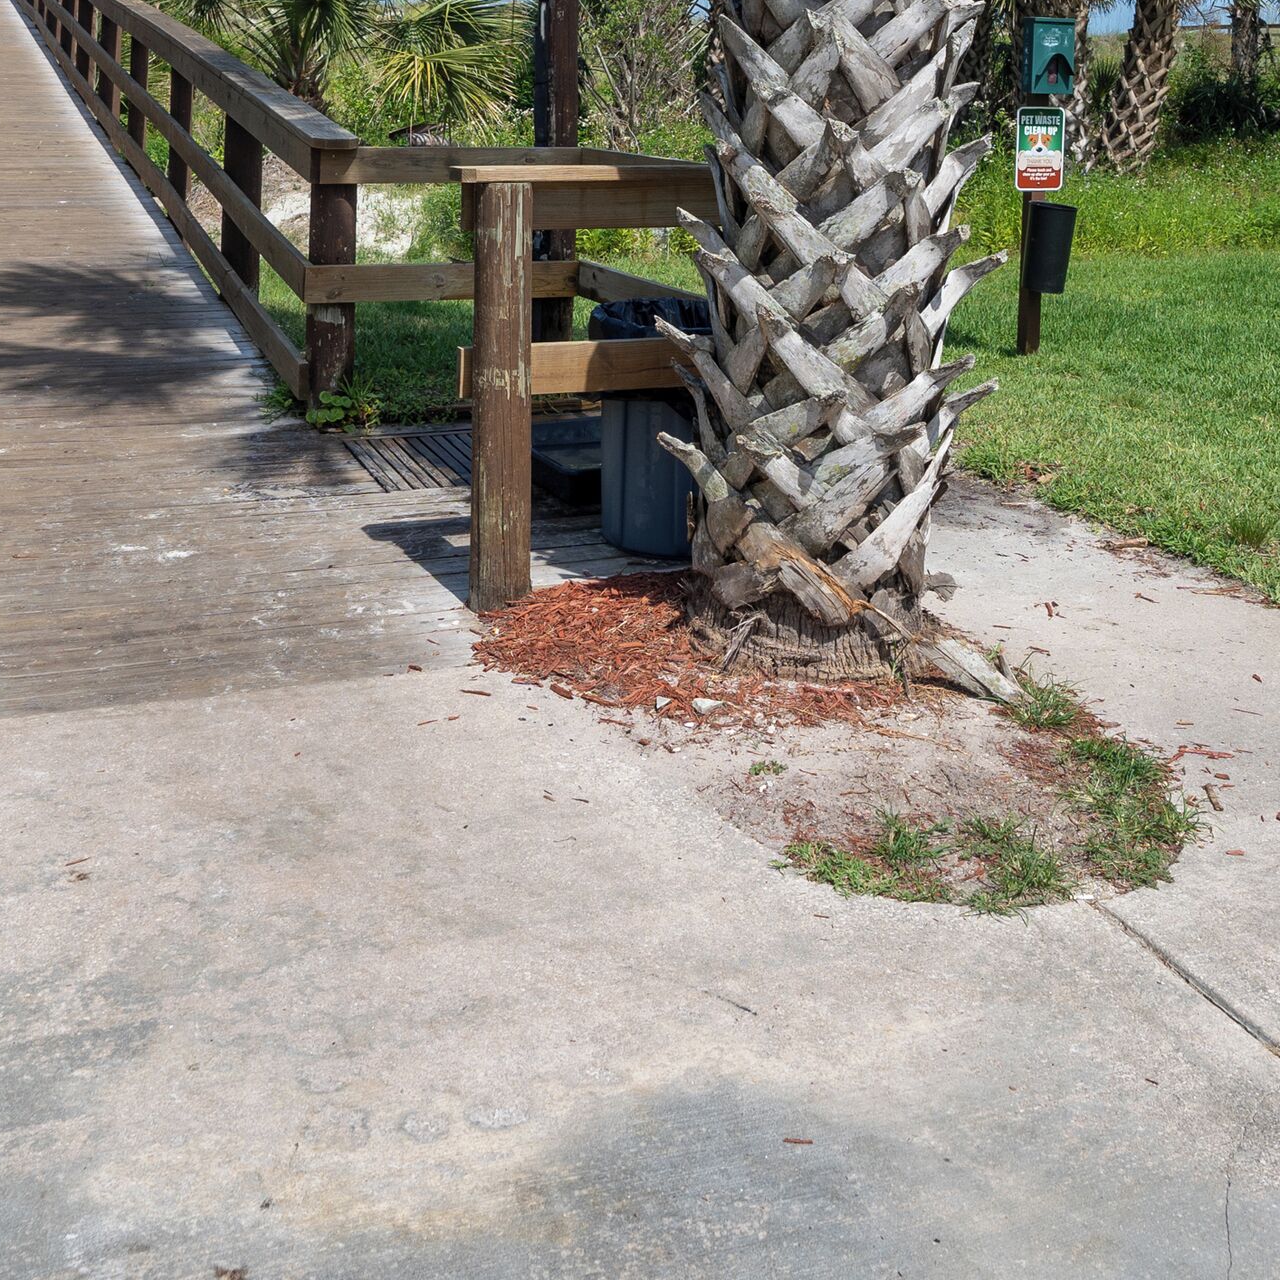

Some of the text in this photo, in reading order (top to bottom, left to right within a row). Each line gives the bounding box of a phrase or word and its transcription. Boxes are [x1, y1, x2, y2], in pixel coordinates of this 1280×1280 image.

[1021, 115, 1060, 125] PET WASTE
[1024, 126, 1058, 135] CLEAN UP
